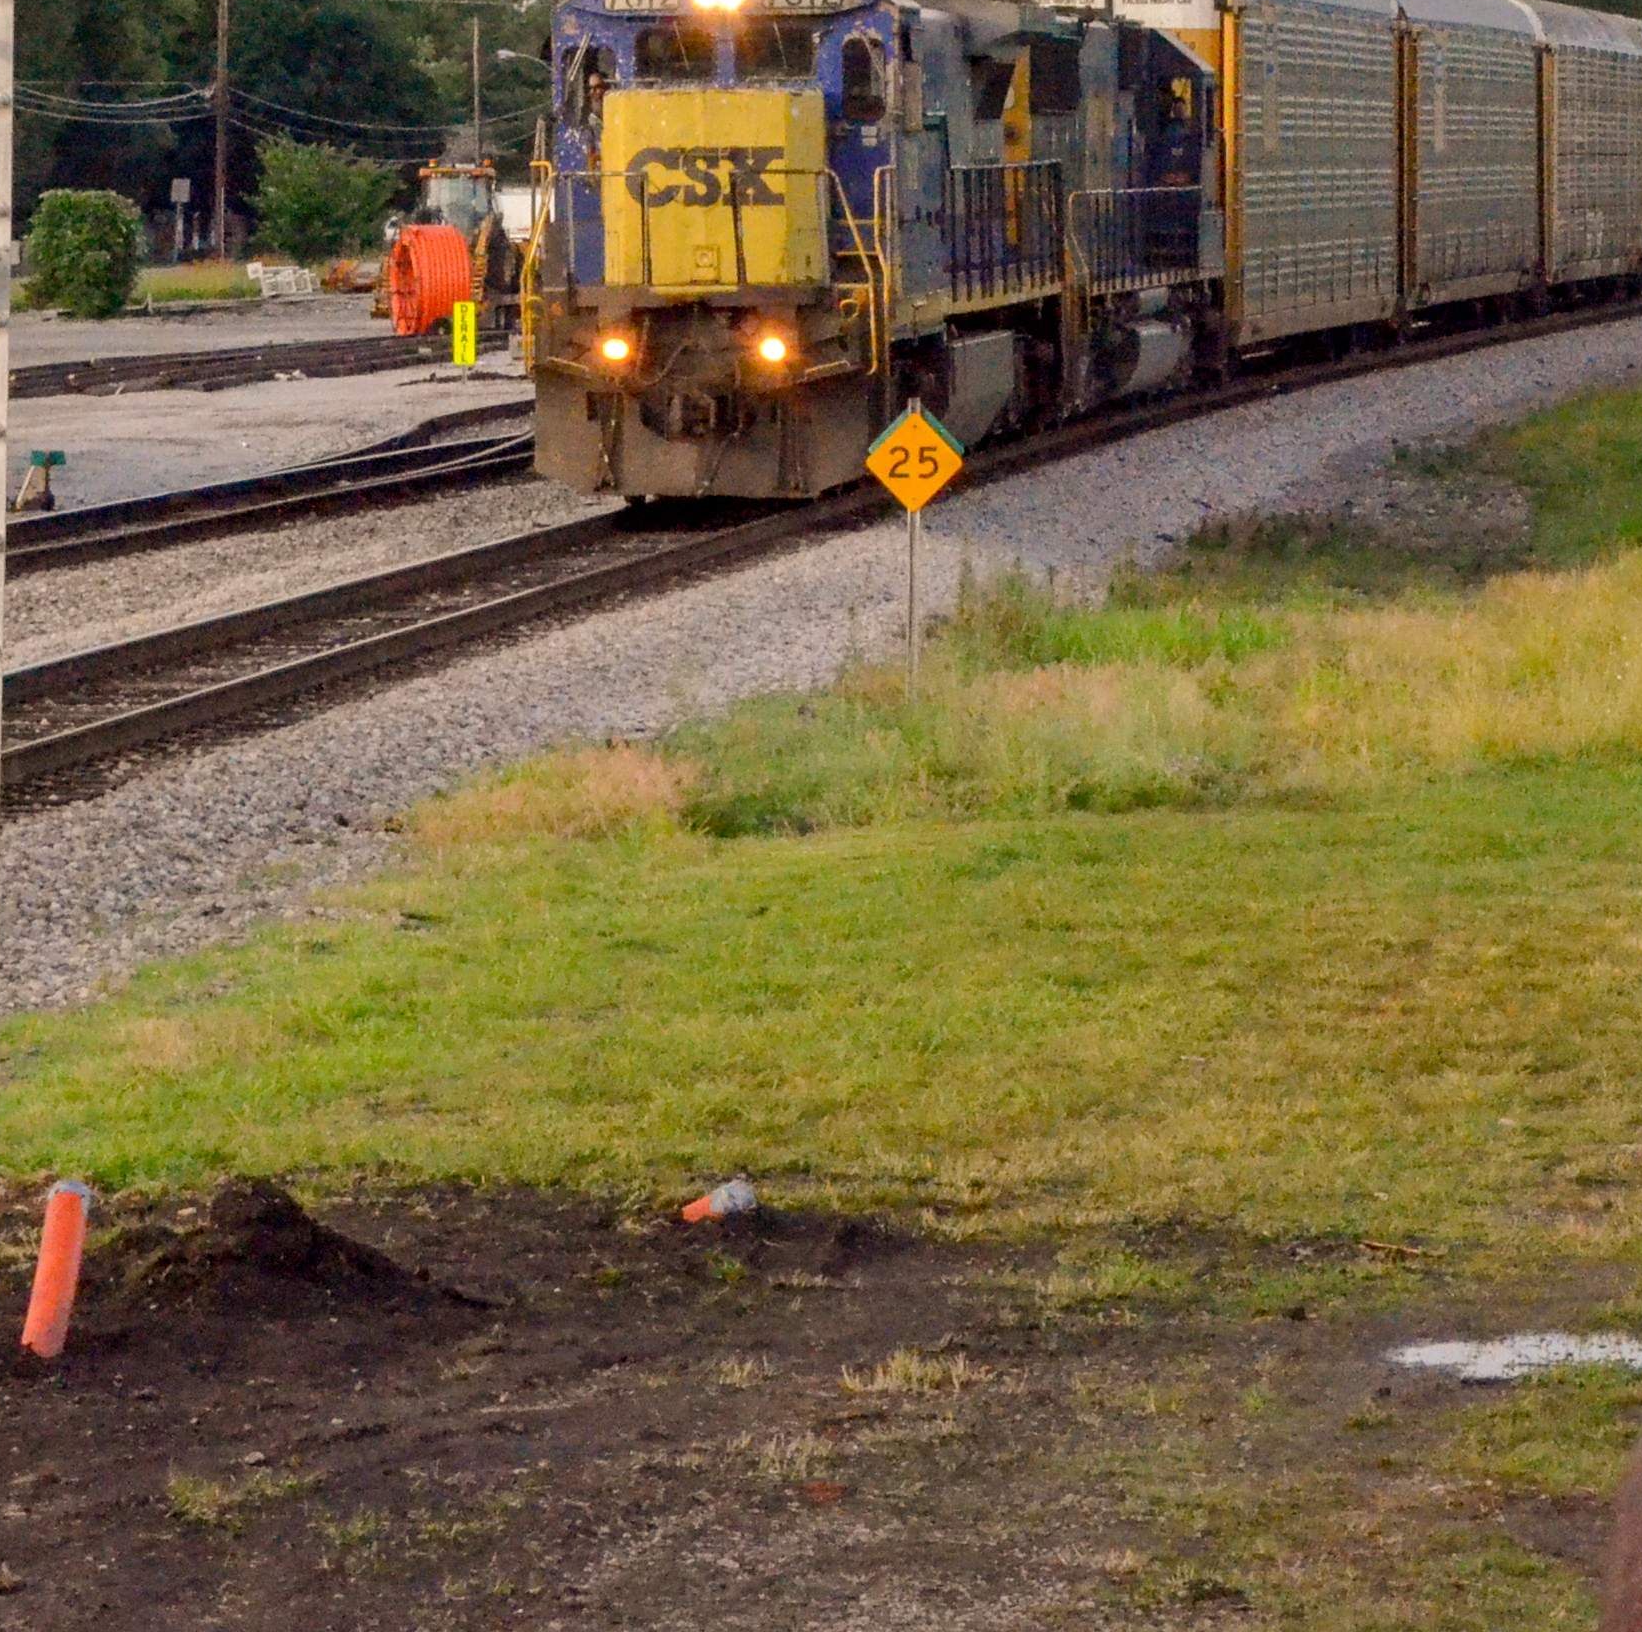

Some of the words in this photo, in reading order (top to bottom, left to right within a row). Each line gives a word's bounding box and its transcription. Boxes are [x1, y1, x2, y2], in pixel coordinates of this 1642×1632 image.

[625, 147, 785, 207] CSX
[460, 304, 469, 363] DERAIL
[888, 446, 939, 479] 25
